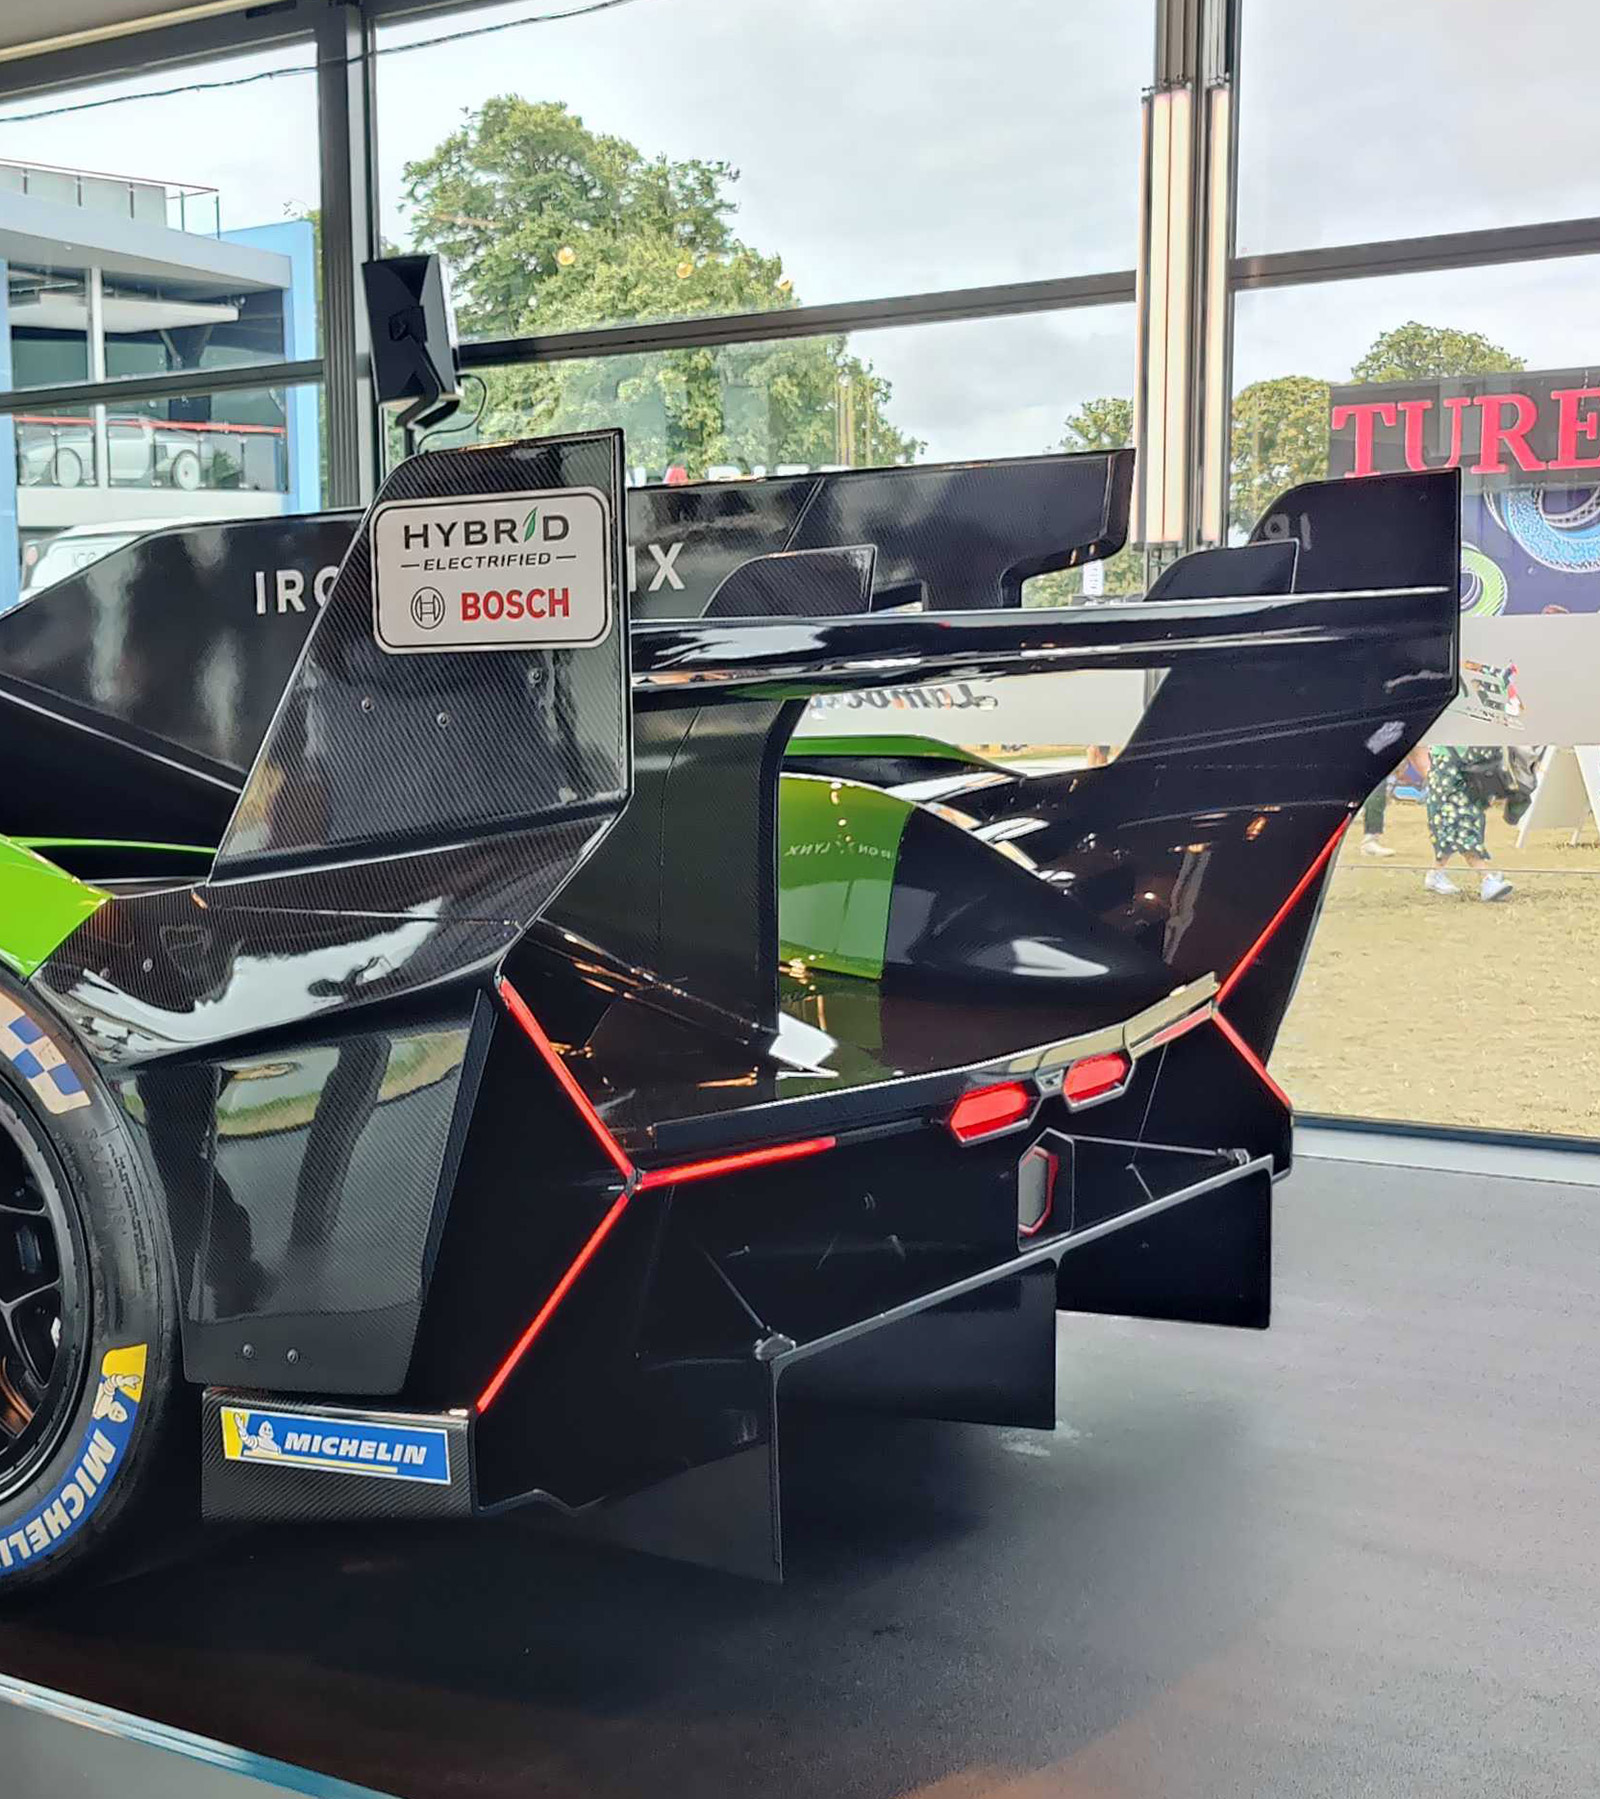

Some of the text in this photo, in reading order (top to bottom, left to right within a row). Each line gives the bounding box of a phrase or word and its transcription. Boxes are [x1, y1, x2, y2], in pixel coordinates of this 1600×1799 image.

[403, 506, 570, 549] HYBRID
[423, 552, 552, 571] ELECTRIFIED
[460, 587, 570, 621] BOSCH
[284, 1431, 427, 1465] MICHELIN
